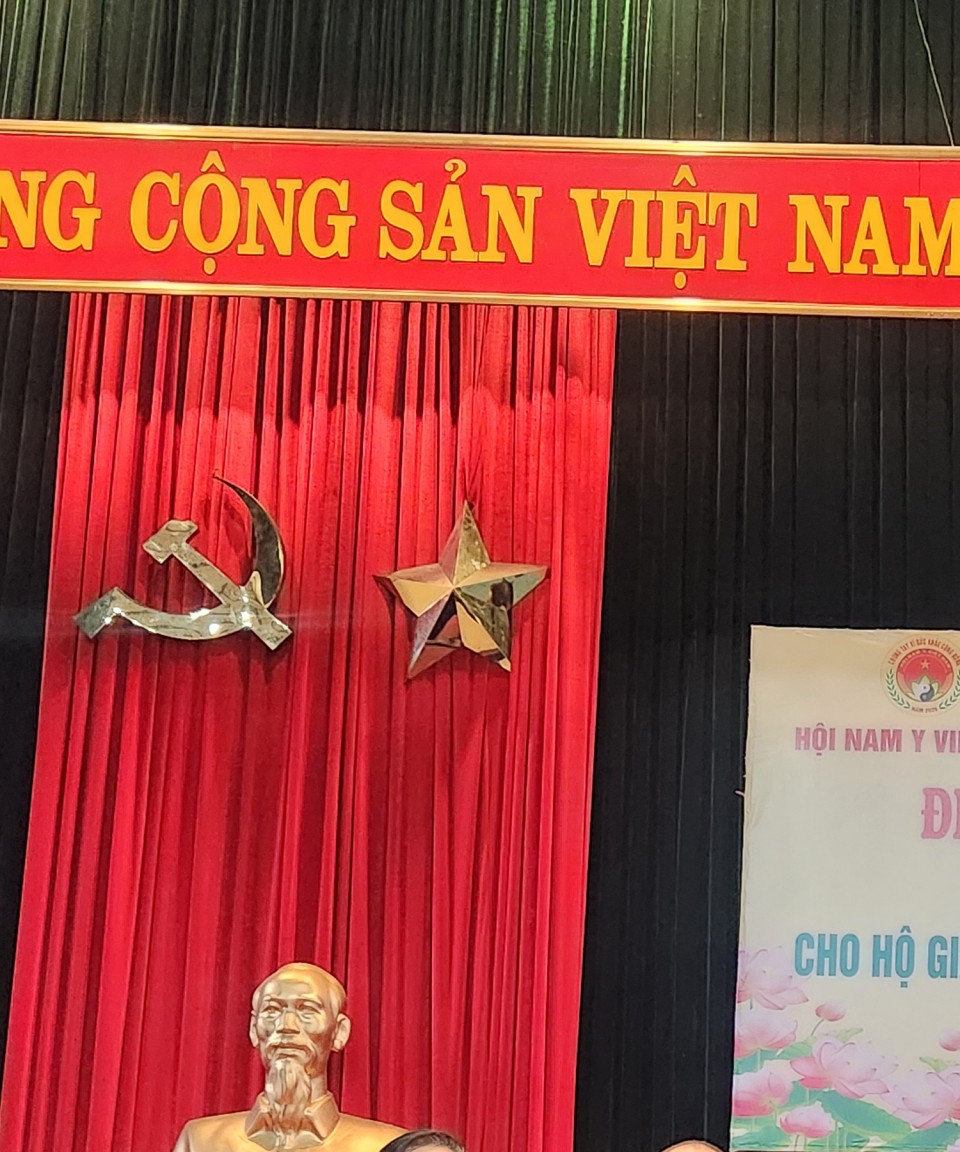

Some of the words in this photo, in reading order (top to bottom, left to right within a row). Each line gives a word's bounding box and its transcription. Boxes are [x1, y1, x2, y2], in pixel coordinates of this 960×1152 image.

[131, 151, 356, 274] CỘNG
[380, 159, 542, 262] SẢN
[570, 165, 757, 288] VIỆT
[795, 723, 836, 756] HỘI
[845, 728, 902, 752] NAM
[912, 729, 926, 752] Y
[794, 933, 860, 977] CHO
[872, 926, 915, 988] HỘ
